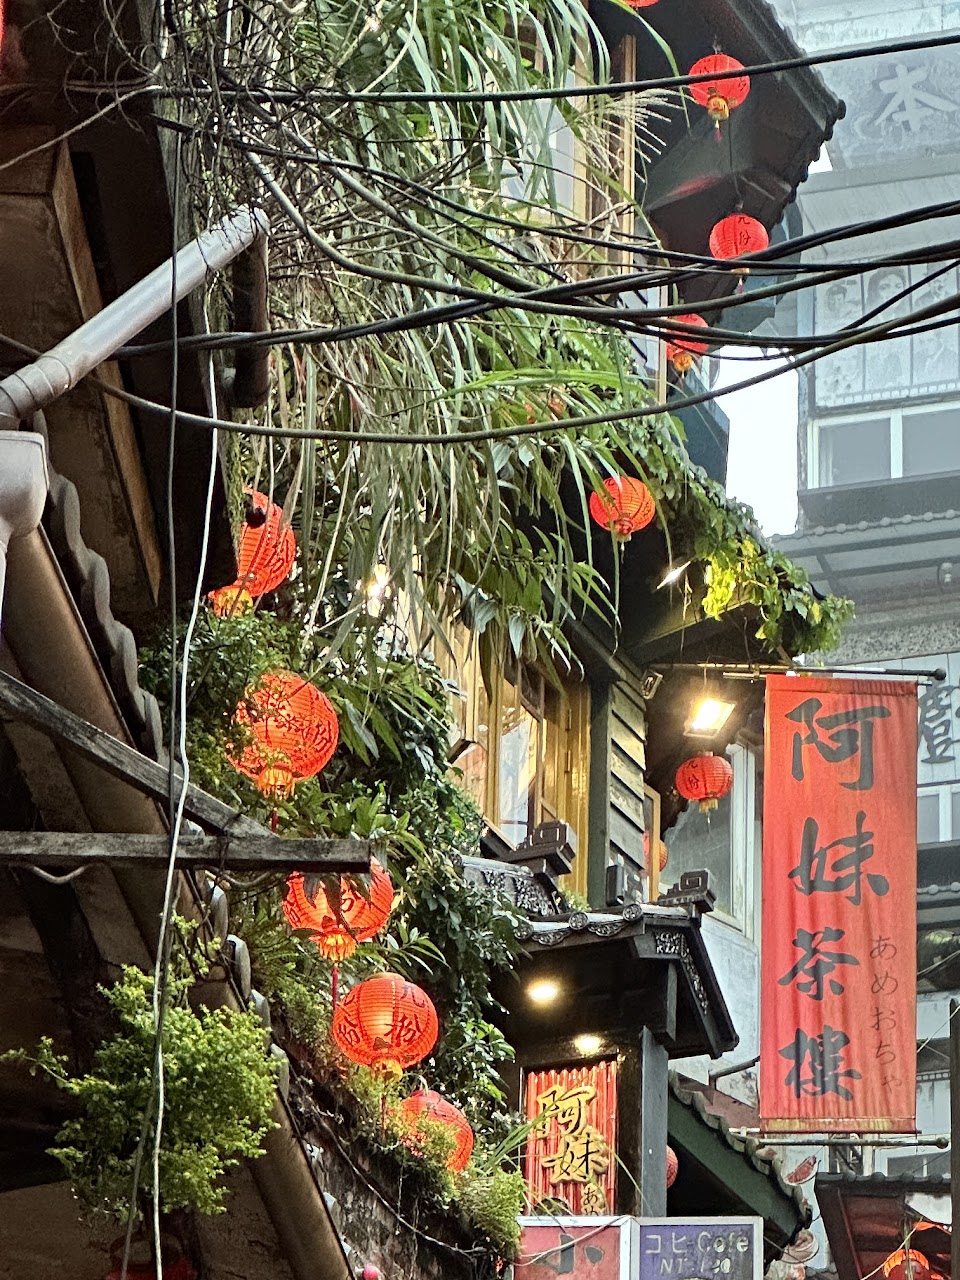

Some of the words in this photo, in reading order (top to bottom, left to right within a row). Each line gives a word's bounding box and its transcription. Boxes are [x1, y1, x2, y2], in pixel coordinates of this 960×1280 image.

[778, 696, 891, 1104] 阿妹茶樓
[536, 1084, 610, 1184] 阿妹
